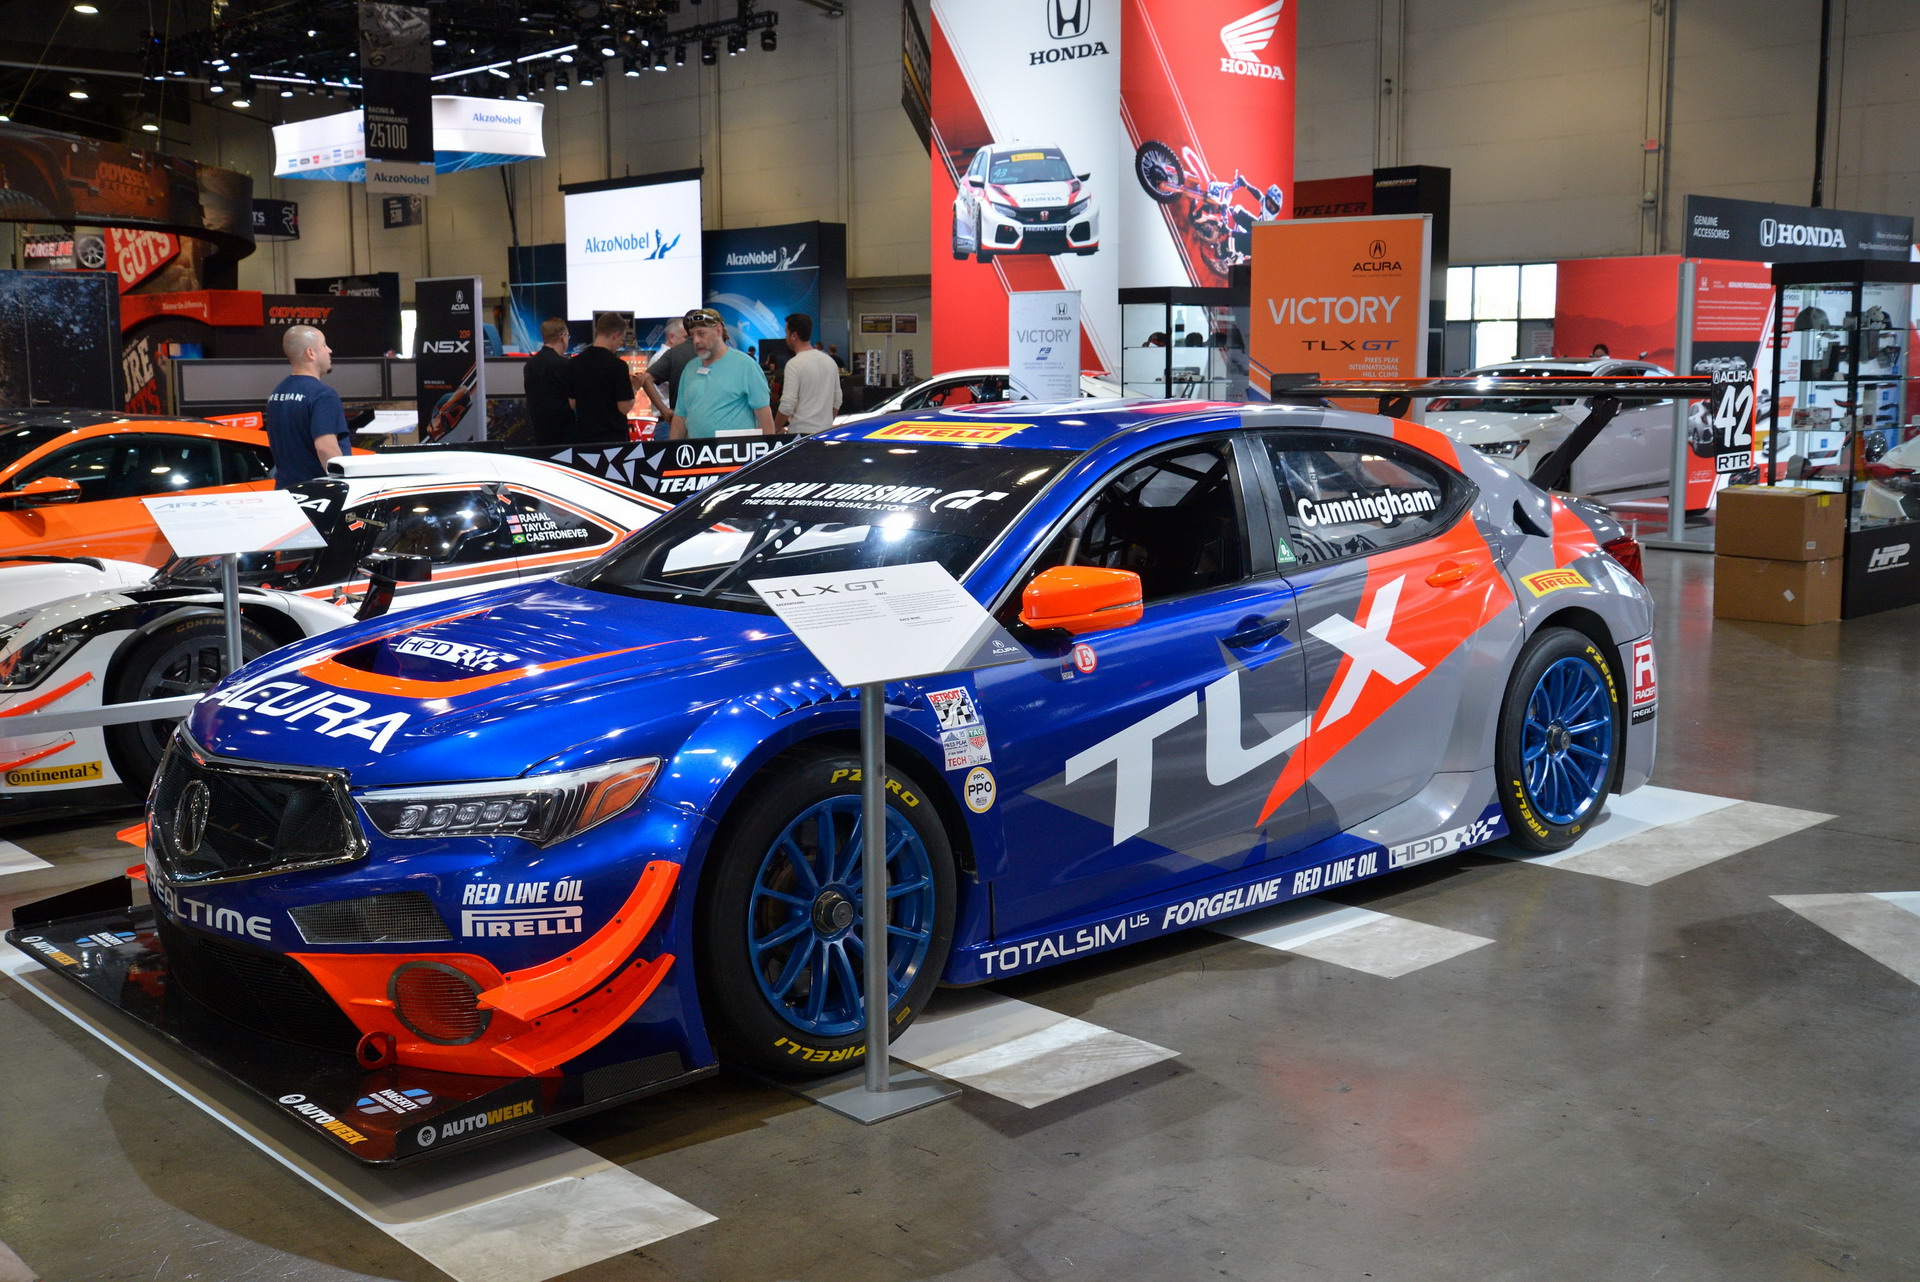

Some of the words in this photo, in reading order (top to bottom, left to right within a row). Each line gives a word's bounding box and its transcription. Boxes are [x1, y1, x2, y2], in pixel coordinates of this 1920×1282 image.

[1029, 41, 1110, 67] HONDA
[1219, 57, 1285, 81] HONDA
[472, 112, 522, 125] AkzoNobel
[369, 122, 409, 150] 25100
[373, 172, 430, 185] AkzoNobel
[1694, 214, 1719, 227] GENUINE
[1693, 226, 1731, 239] ACCESSORIES
[1776, 222, 1847, 249] HONDA
[24, 240, 75, 258] FORGELINE
[585, 232, 649, 254] AkzoNobel
[726, 250, 777, 267] AkzoNobel
[1352, 261, 1403, 272] ACURA
[268, 306, 332, 319] ODYSSEY
[451, 303, 470, 311] ACURA
[1267, 295, 1402, 326] VICTORY
[1016, 329, 1072, 343] VICTORY
[422, 340, 471, 354] NSX
[1301, 340, 1356, 351] TLX
[1361, 340, 1400, 351] GT
[1348, 363, 1400, 371] INTERNATIONAL
[1364, 356, 1382, 364] PIKES
[1719, 370, 1755, 383] ACURA
[1713, 384, 1755, 448] 42
[884, 424, 1009, 439] PIRELLI
[1718, 453, 1750, 470] RTR
[660, 475, 719, 494] TEAM
[750, 482, 827, 499] GRAN
[811, 482, 936, 504] TURISMO
[789, 499, 834, 508] DRIVING
[834, 500, 910, 512] SIMULATOR
[1297, 487, 1437, 528] Cunningham
[519, 512, 551, 523] RAHAL
[522, 521, 558, 533] TAYLOR
[525, 528, 589, 542] CASTRONEVES
[764, 584, 840, 599] TLX
[844, 579, 884, 591] GT
[1529, 571, 1583, 592] PIRELLI
[401, 637, 453, 657] HPD
[992, 646, 1019, 655] ACURA
[1078, 647, 1093, 669] E
[928, 689, 961, 703] DETROIT
[199, 679, 412, 754] ACURA
[1065, 573, 1427, 847] TLX
[968, 728, 984, 737] TAG
[947, 756, 967, 768] TECH
[5, 764, 87, 786] Continental
[973, 773, 985, 781] PPC
[830, 768, 920, 808] PZRO
[968, 781, 992, 797] PPO
[1512, 779, 1549, 838] PIRELLI
[1392, 834, 1448, 866] HPD
[462, 883, 501, 905] RED
[504, 881, 550, 905] LINE
[553, 879, 584, 902] OIL
[461, 905, 583, 937] PIRELLI
[980, 919, 1128, 974] TOTALSIM
[1129, 913, 1150, 928] US
[1161, 877, 1283, 930] FORGELINE
[1292, 868, 1322, 896] RED
[1323, 859, 1356, 889] LINE
[1356, 851, 1379, 878] OIL
[379, 1088, 421, 1112] HAGERTY
[293, 1102, 369, 1146] AUTOWEEK
[441, 1099, 535, 1140] AUTOWEEK
